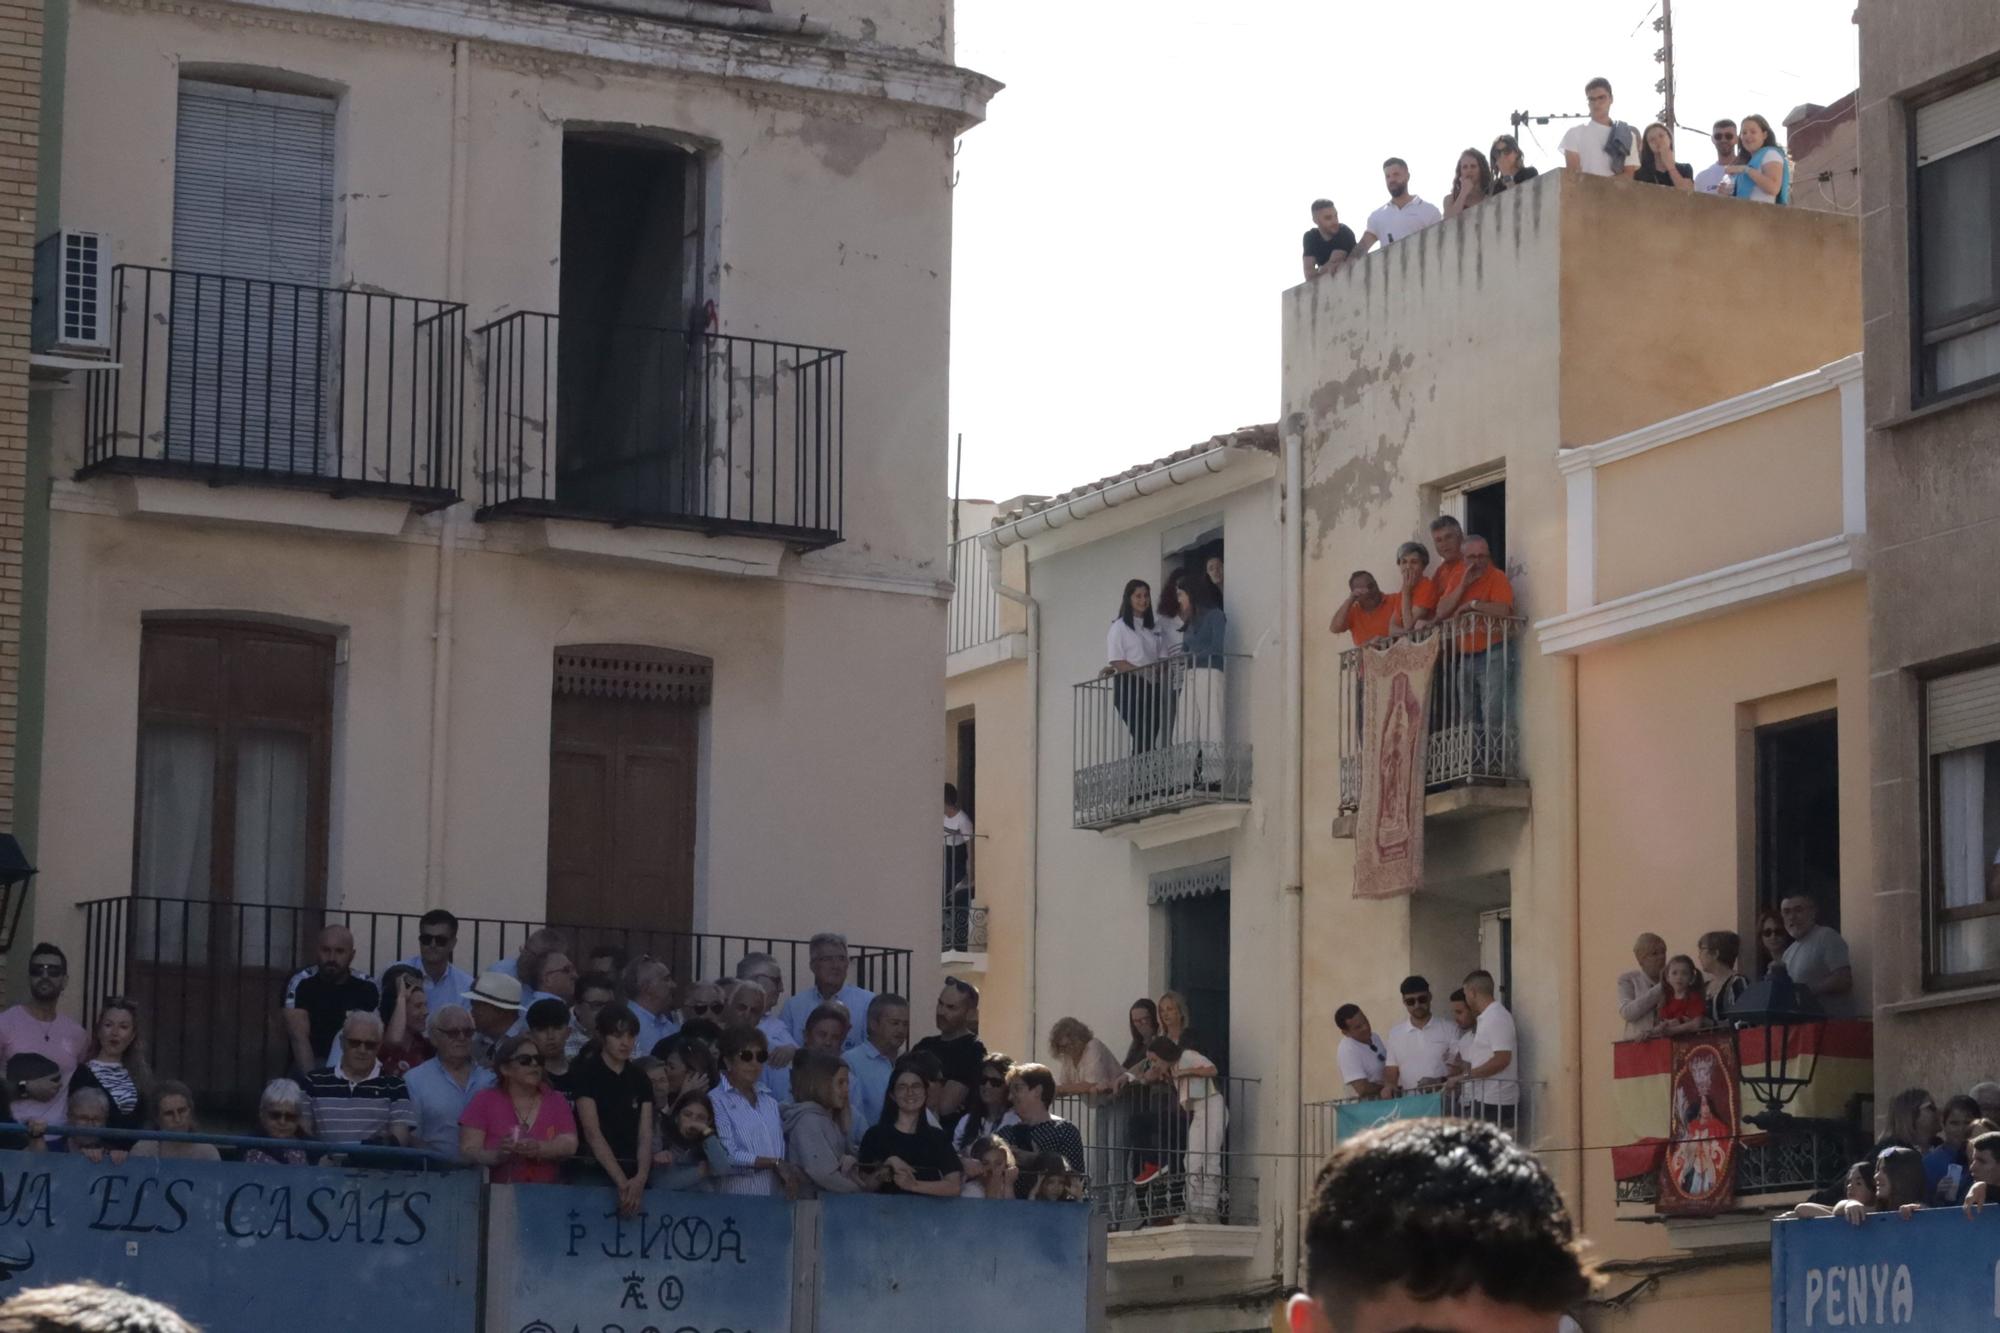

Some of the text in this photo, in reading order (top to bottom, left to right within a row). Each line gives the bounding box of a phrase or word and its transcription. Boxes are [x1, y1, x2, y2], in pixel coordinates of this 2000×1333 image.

[88, 1175, 194, 1234] ELS
[223, 1182, 432, 1246] CASATS
[1805, 1262, 1914, 1327] PENYA
